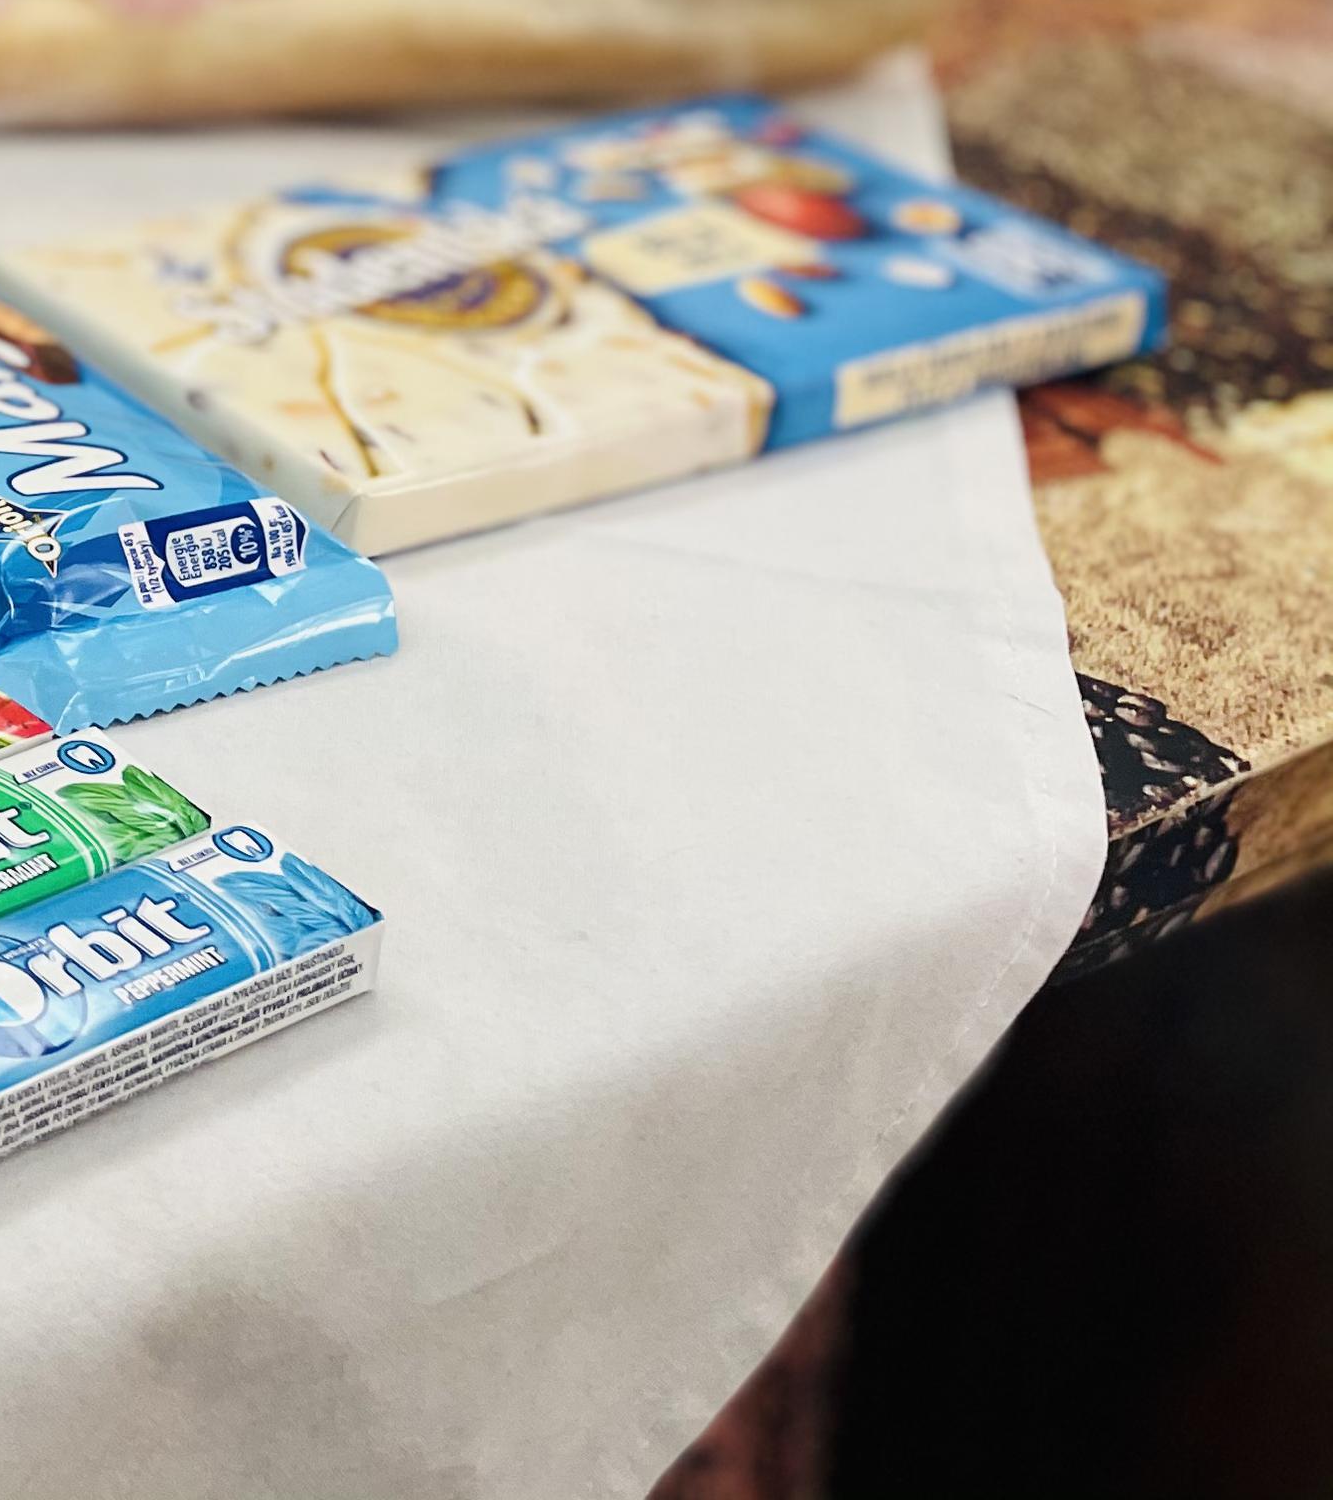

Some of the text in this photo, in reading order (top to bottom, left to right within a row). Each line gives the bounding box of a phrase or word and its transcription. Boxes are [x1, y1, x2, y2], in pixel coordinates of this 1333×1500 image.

[171, 537, 190, 581] Energie
[182, 533, 202, 579] Energia
[201, 548, 218, 570] 858
[217, 549, 233, 571] 205
[112, 945, 228, 1006] PEPPERMINT
